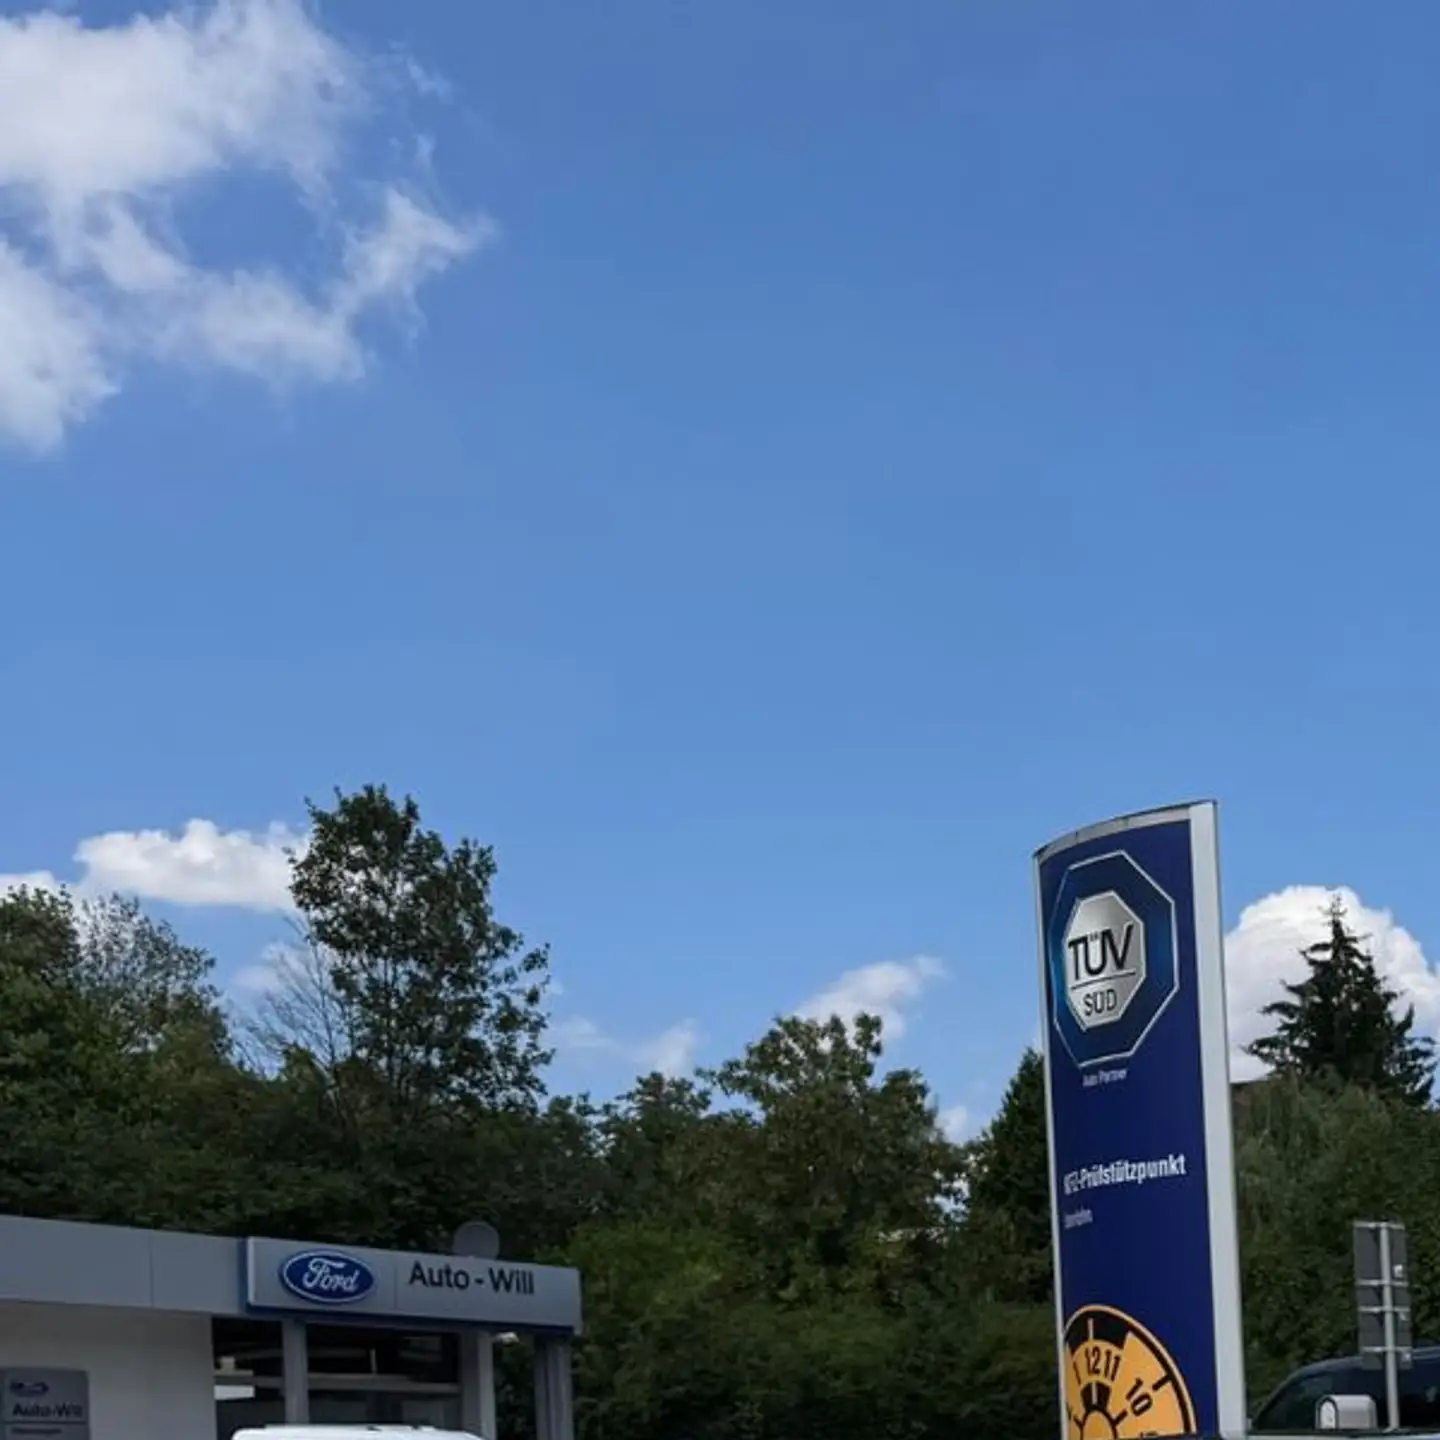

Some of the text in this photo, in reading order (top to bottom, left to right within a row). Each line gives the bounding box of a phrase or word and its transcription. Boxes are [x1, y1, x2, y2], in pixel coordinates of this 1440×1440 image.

[1067, 921, 1134, 981] TÜV
[1082, 988, 1118, 1017] SÜD
[302, 1257, 358, 1293] Ford
[408, 1260, 470, 1290] Auto
[488, 1267, 535, 1295] Will
[1084, 1346, 1101, 1376] 12
[1104, 1350, 1122, 1382] 11
[1125, 1377, 1154, 1417] 10
